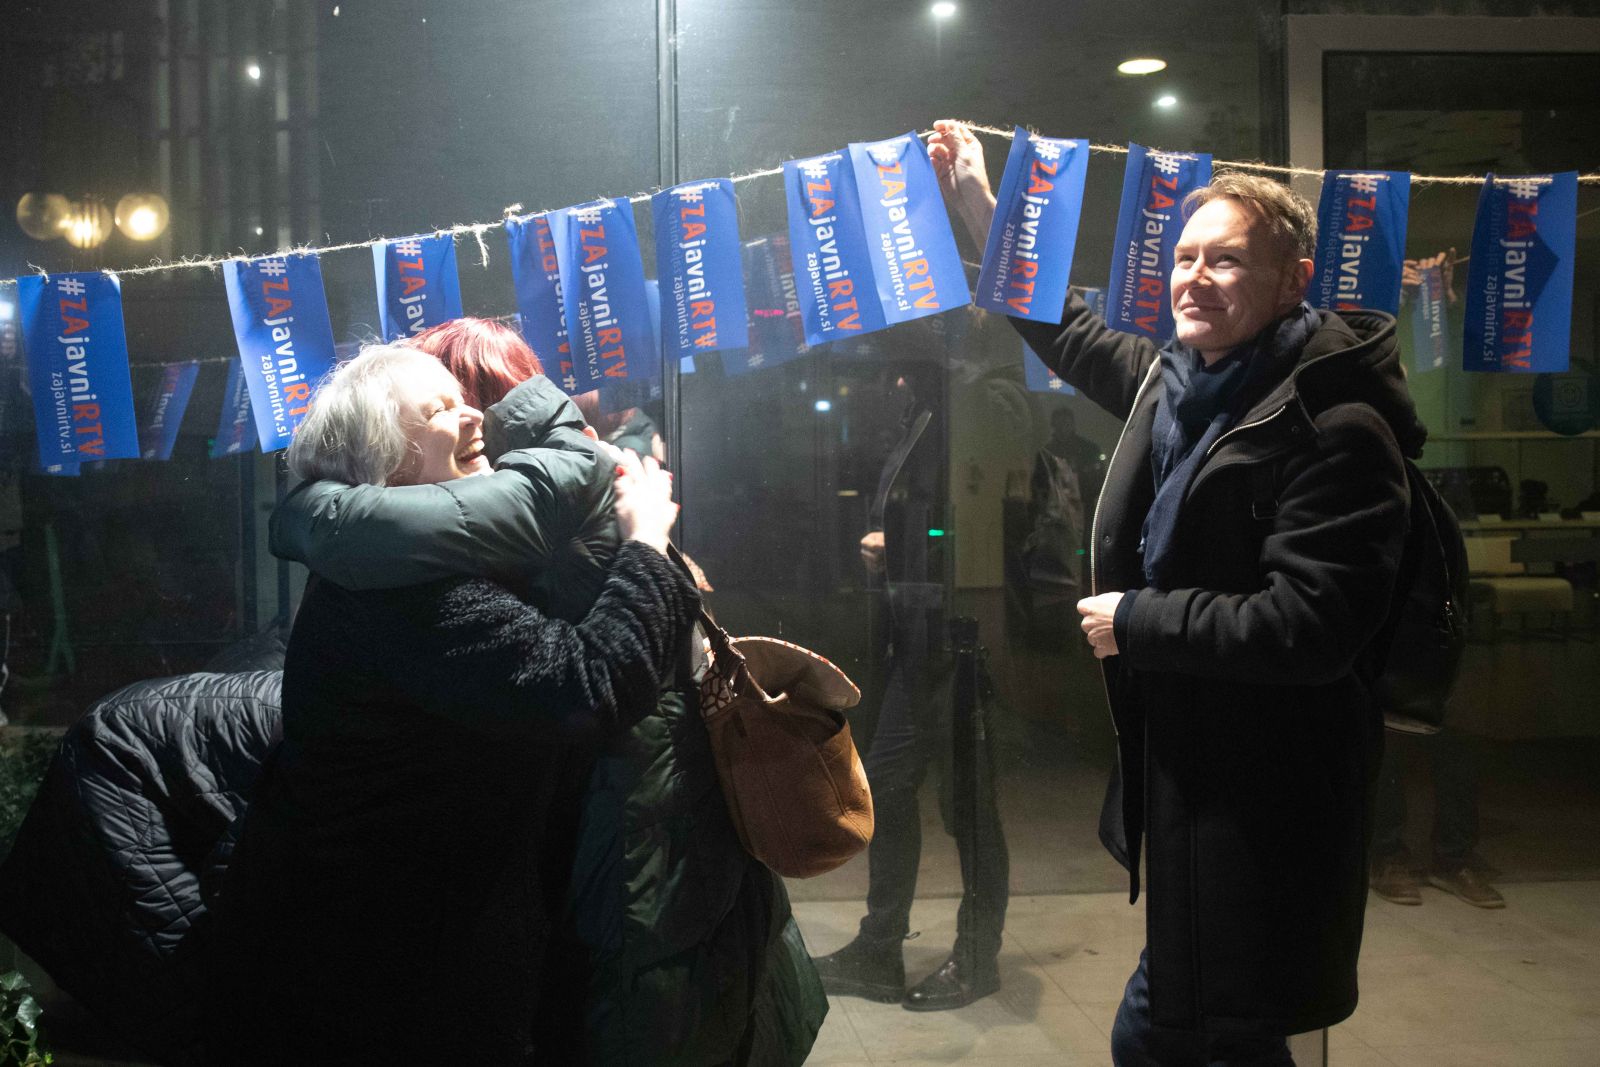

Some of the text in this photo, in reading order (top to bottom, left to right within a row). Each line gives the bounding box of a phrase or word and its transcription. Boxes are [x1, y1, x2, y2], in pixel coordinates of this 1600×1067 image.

[679, 186, 718, 348] #ZAjavniRTV
[804, 160, 863, 331] #ZAjavniRTV
[872, 142, 941, 309] #ZAjavniRTV
[880, 232, 912, 312] zajavnirtv.si
[992, 223, 1016, 303] zajavnirtv.si
[1006, 140, 1061, 315] #ZAjavniRTV
[1135, 155, 1180, 334] #ZAjavniRTV
[1336, 177, 1378, 310] #ZAjavni
[1500, 181, 1539, 368] #ZAjavniRTV
[395, 240, 427, 332] #ZAjav
[577, 208, 628, 378] #ZAjavniRTV
[673, 276, 692, 349] zajavnirtv.si
[806, 251, 834, 332] zajavnirtv.si
[1120, 240, 1139, 326] zajavnirtv.si
[1482, 275, 1500, 361] zajavnirtv.si
[57, 277, 105, 456] #ZAjavniRTV
[258, 257, 313, 434] #ZAjavniRT
[261, 354, 291, 437] zajavnirtv.si
[578, 301, 602, 380] zajavnirtv.si
[51, 371, 75, 454] zajavnirtv.si
